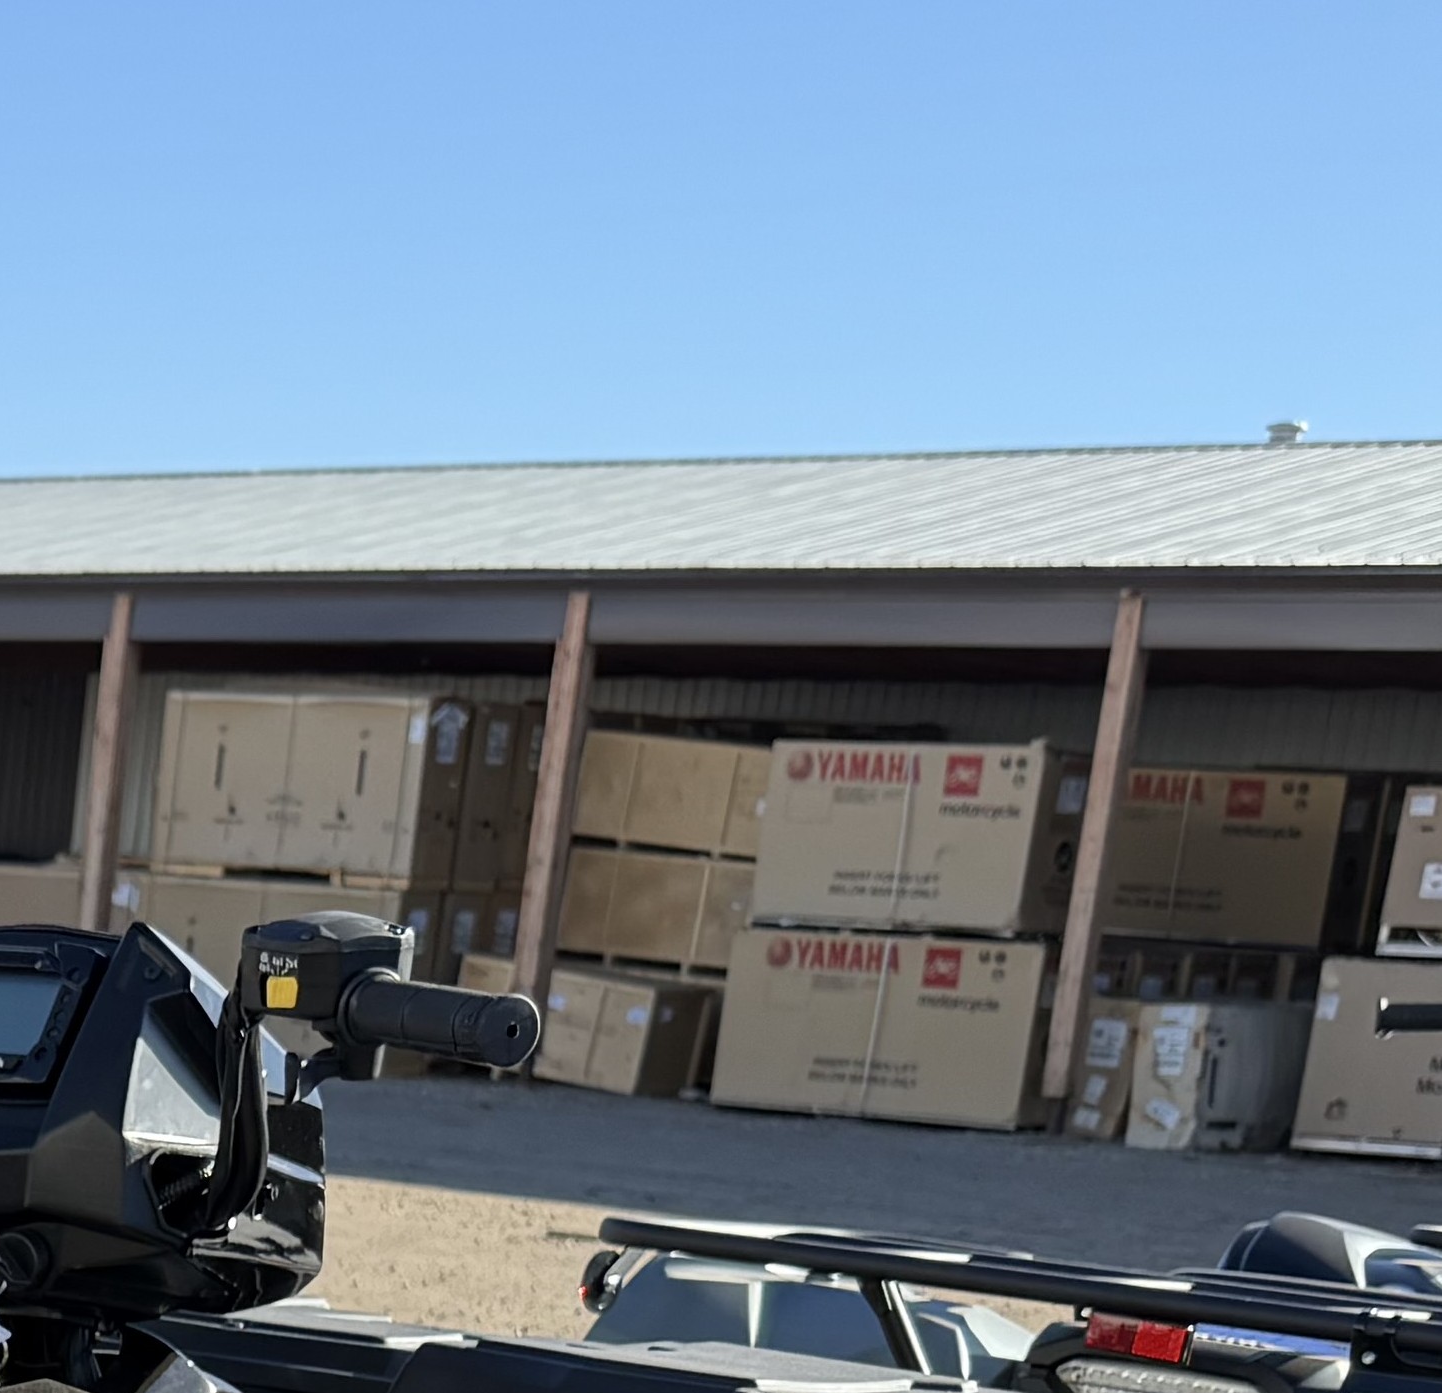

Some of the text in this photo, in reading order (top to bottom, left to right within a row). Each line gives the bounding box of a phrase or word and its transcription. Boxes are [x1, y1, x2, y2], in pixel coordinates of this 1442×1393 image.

[817, 750, 921, 784] YAMAHA
[1131, 773, 1204, 804] MAHA
[939, 801, 1021, 821] motorcycle
[796, 939, 901, 974] YAMAHA
[918, 994, 1000, 1013] motorcycle
